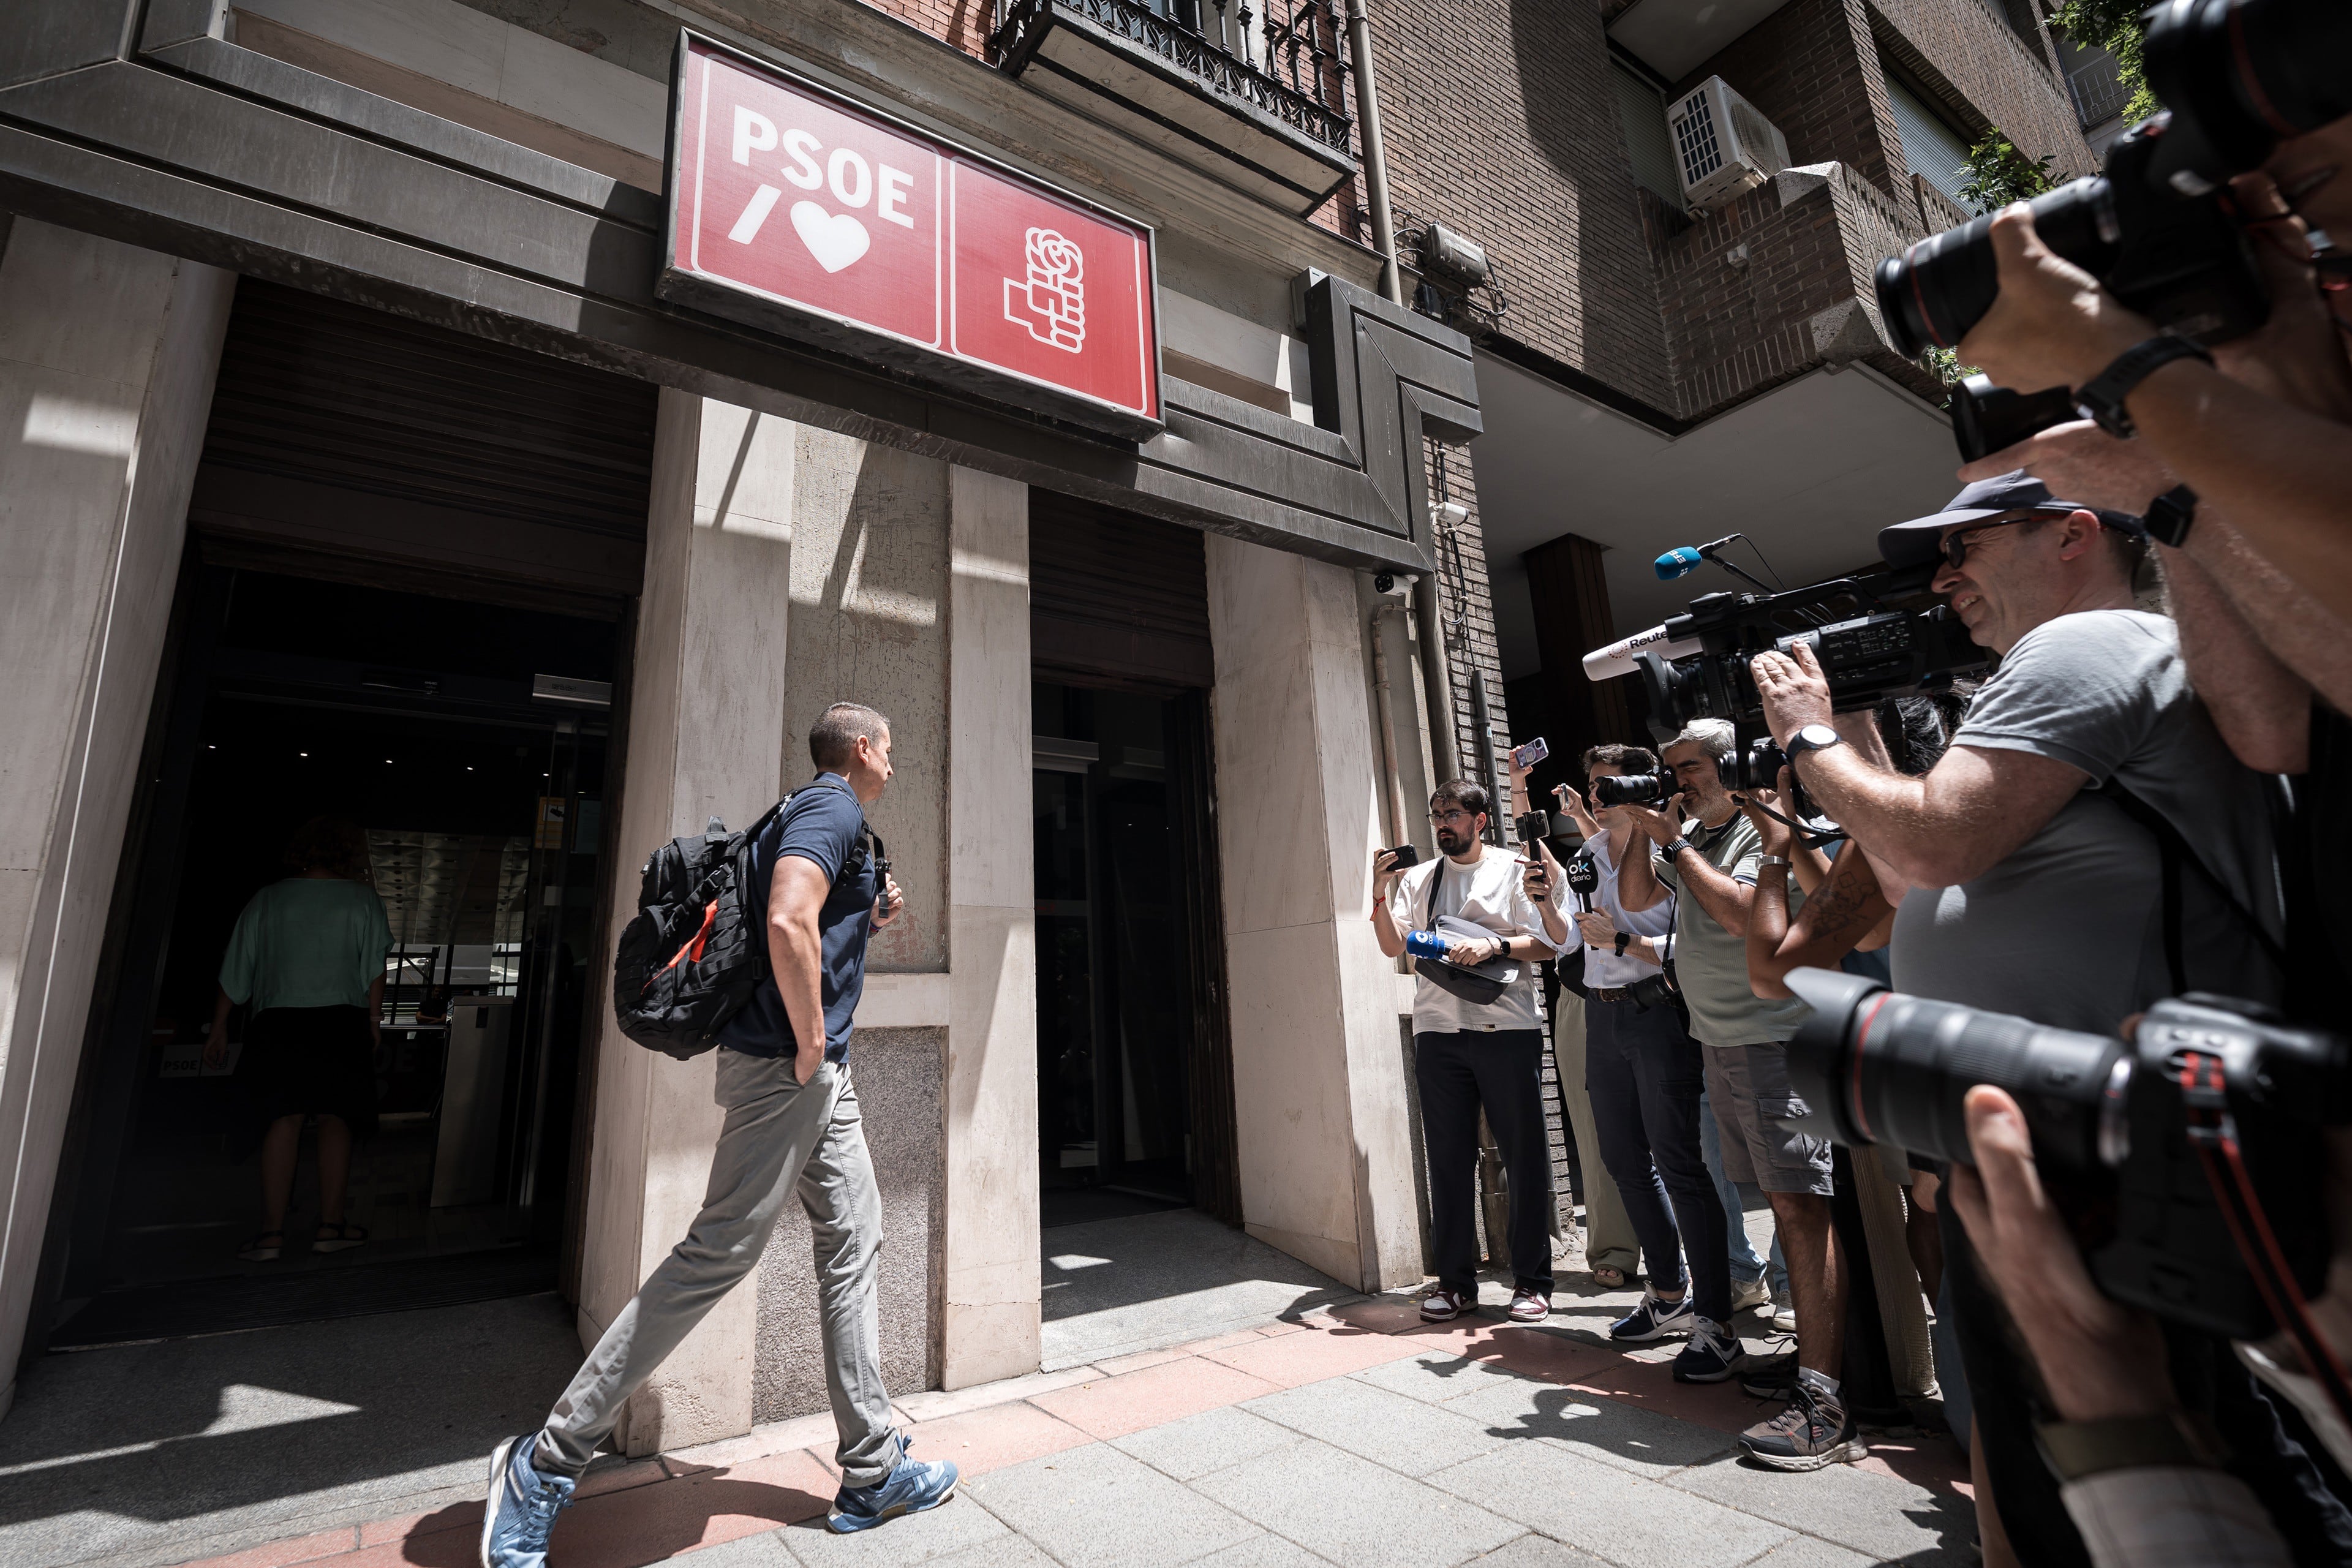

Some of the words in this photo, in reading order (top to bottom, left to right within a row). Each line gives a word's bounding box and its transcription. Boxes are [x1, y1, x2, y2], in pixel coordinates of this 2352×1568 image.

[731, 105, 914, 230] PSOE
[1630, 631, 1668, 649] Reute
[1571, 873, 1591, 883] diario
[164, 1061, 197, 1071] PSOE
